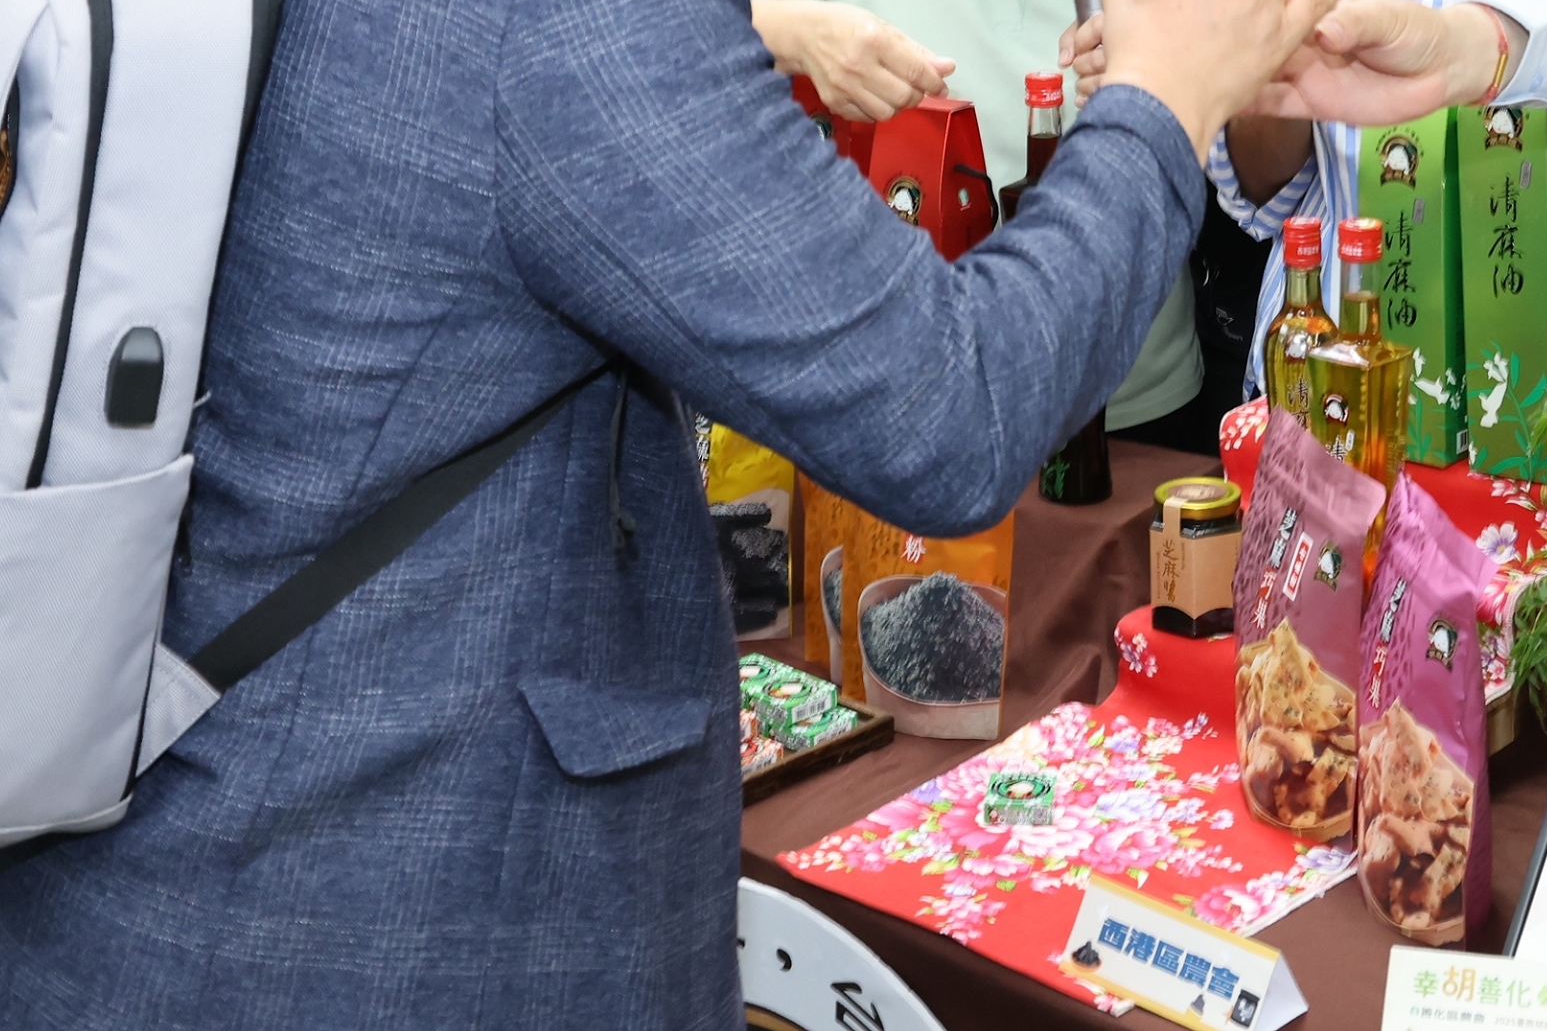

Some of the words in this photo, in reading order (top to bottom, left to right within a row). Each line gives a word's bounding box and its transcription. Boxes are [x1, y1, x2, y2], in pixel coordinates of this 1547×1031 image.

[1097, 917, 1240, 1001] 西港區農會
[1413, 965, 1533, 1008] 幸胡善化
